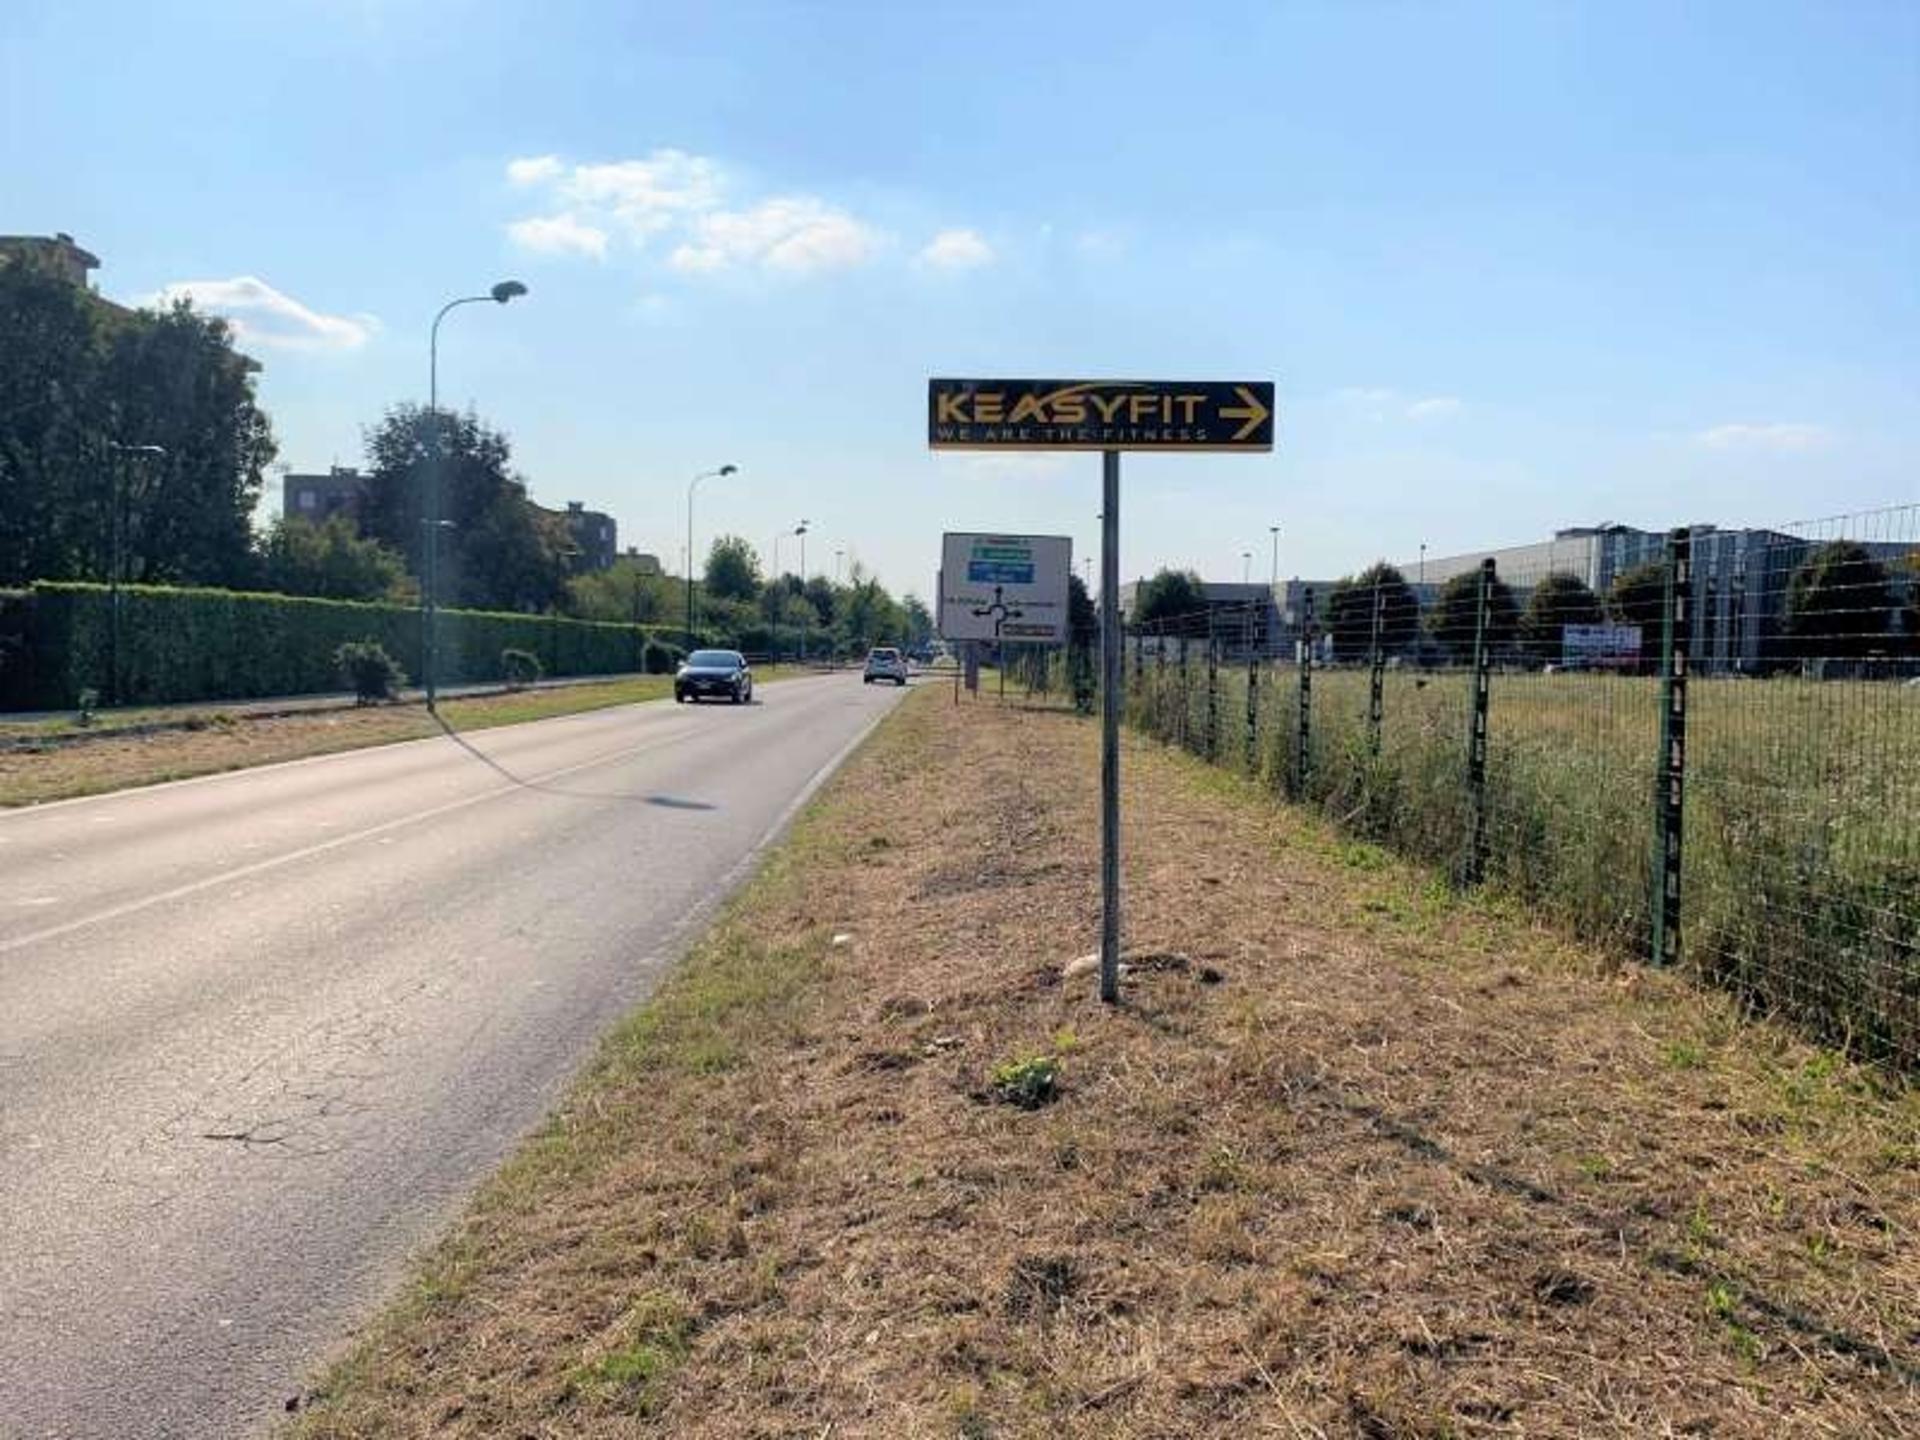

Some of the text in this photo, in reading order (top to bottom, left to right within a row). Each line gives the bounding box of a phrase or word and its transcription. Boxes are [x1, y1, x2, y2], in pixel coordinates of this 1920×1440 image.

[937, 391, 1209, 424] KEASYFIT
[938, 428, 1208, 441] WE ARE THE FITNESS
